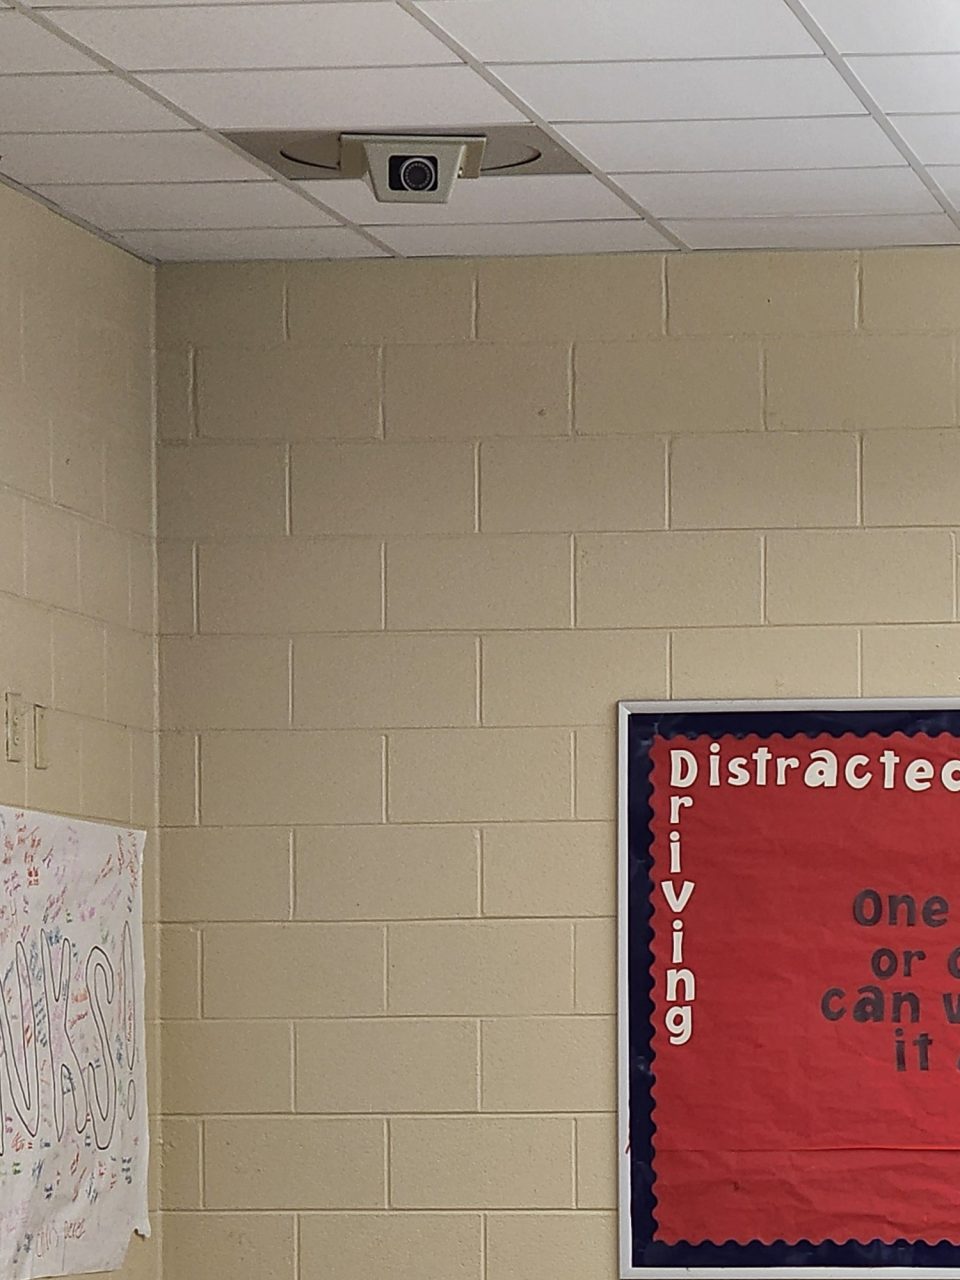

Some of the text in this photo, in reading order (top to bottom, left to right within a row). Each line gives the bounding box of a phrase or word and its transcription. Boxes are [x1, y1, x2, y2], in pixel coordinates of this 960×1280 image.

[852, 888, 949, 928] One
[870, 947, 927, 981] or
[820, 985, 921, 1023] can
[895, 1027, 933, 1072] it
